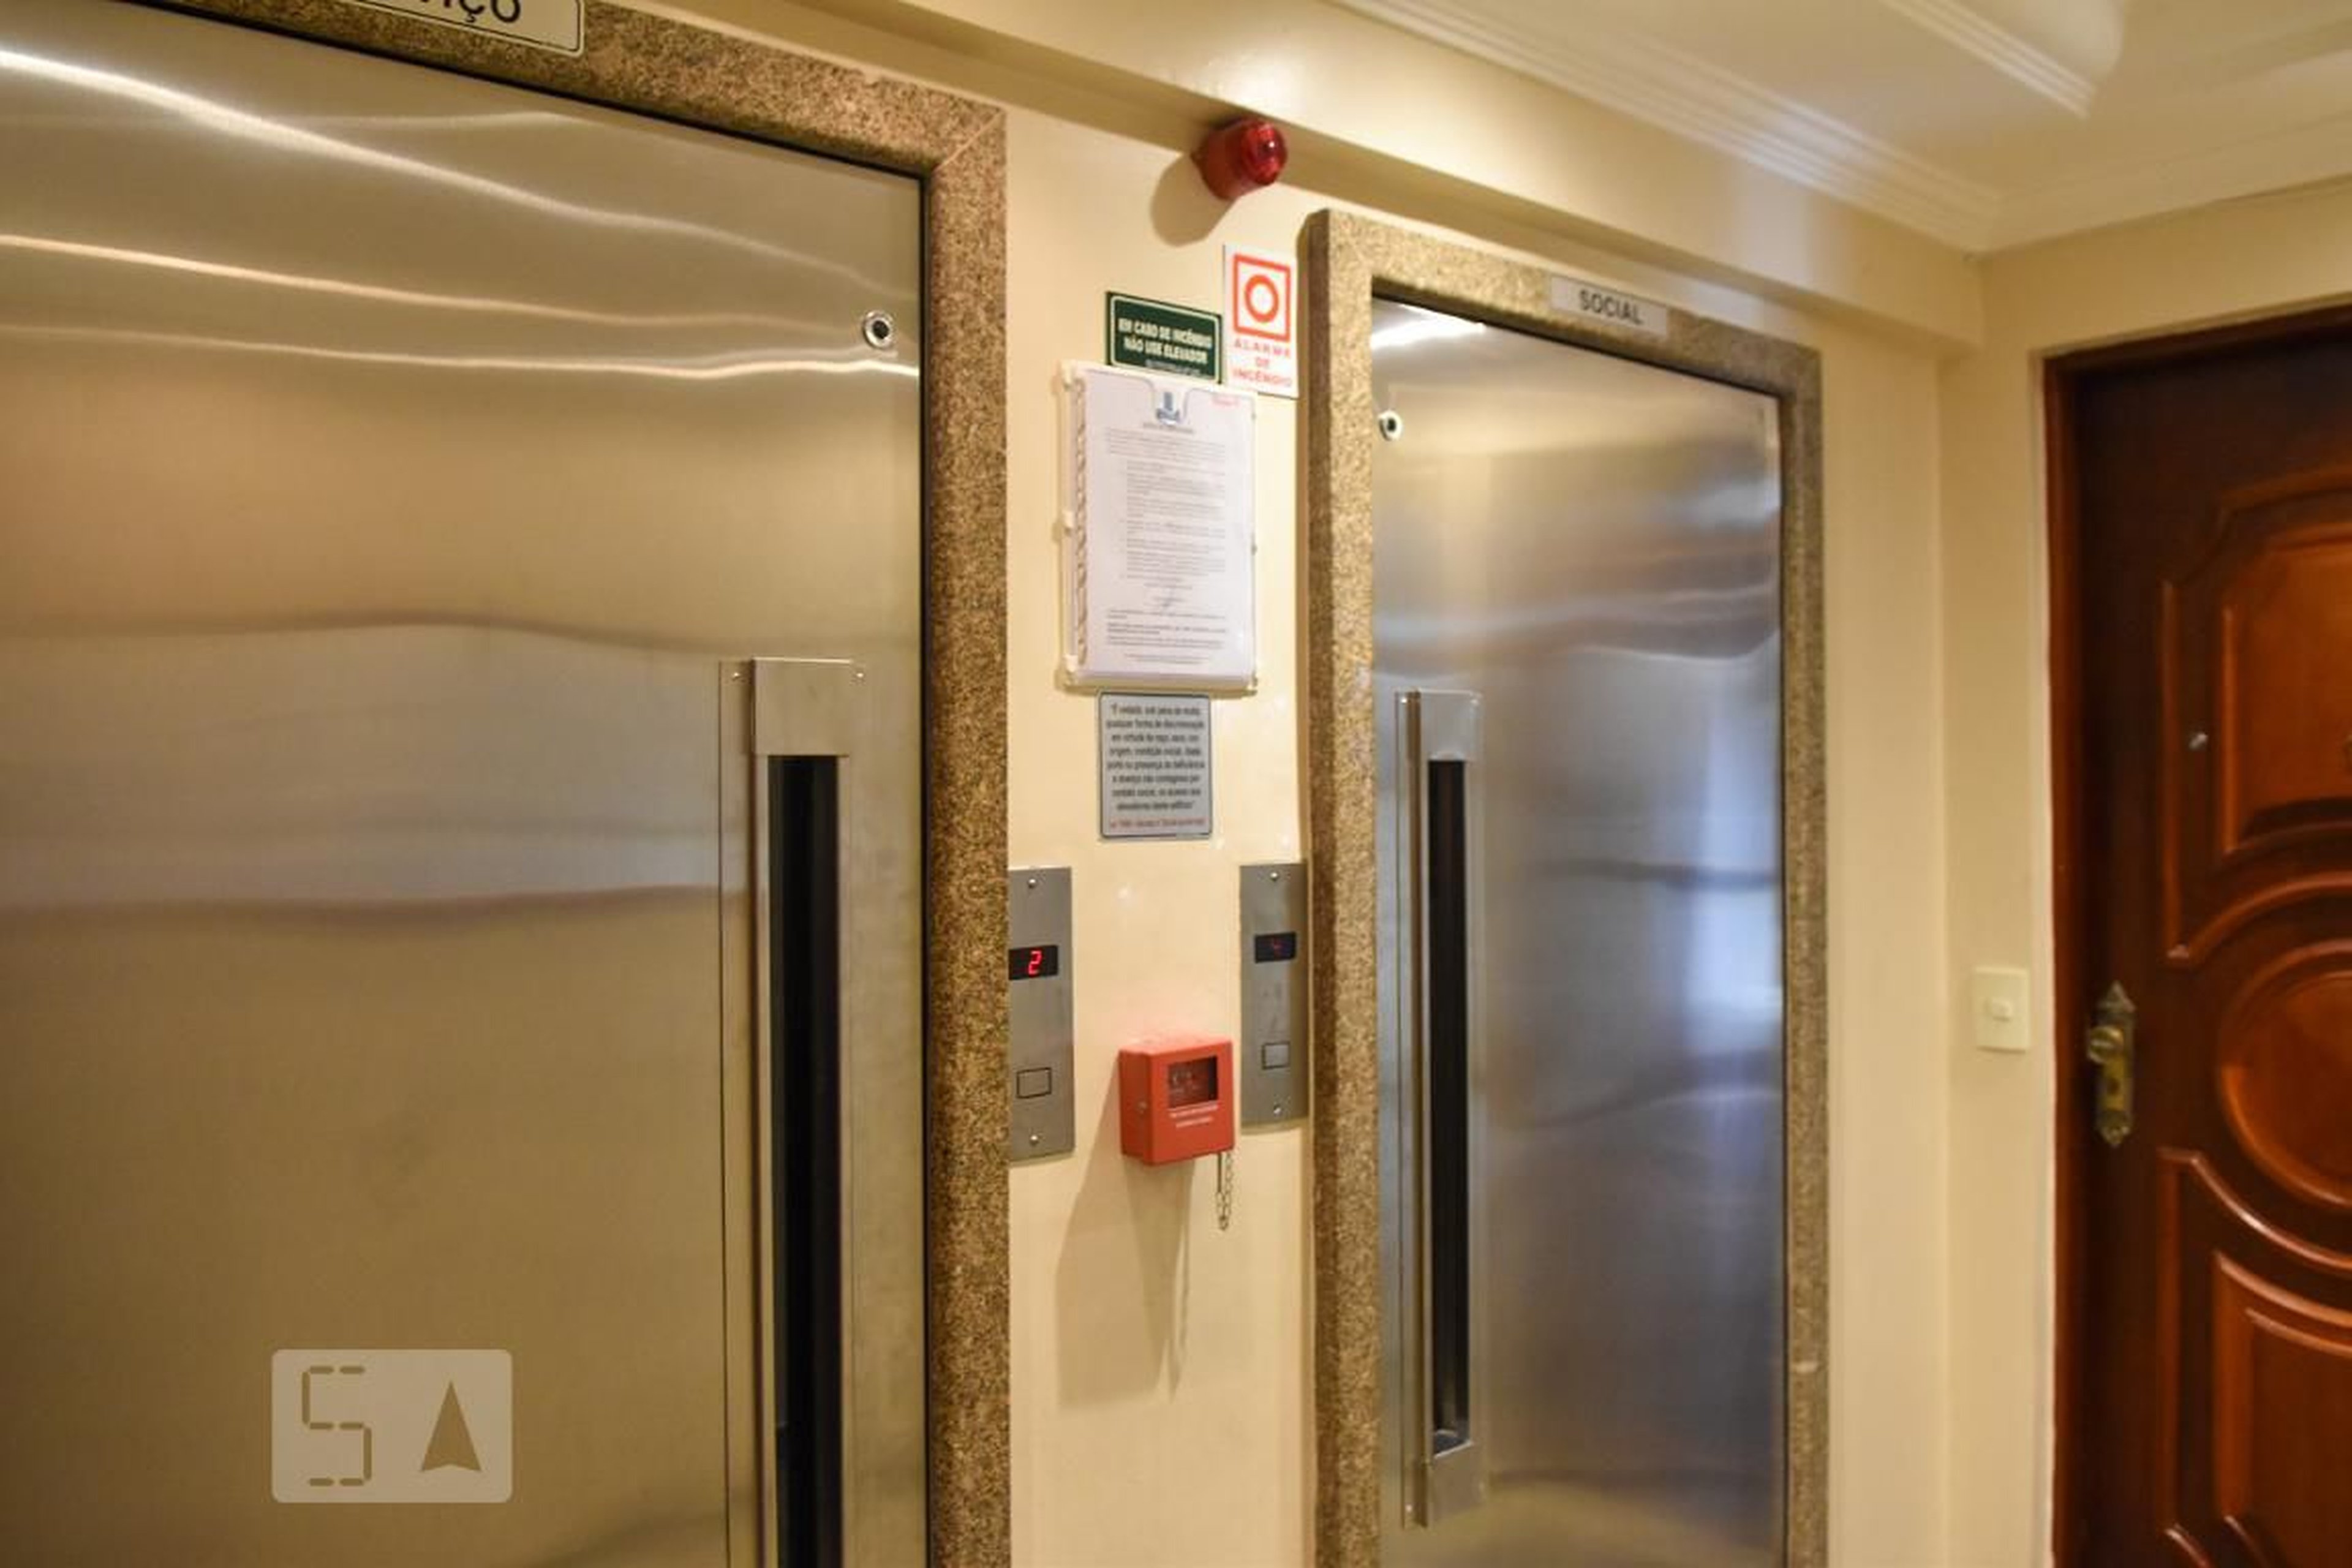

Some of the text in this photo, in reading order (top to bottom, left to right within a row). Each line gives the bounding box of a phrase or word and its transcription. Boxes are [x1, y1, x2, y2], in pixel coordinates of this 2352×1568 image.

[1580, 288, 1643, 325] SOCIAL
[1134, 320, 1158, 337] CASO
[1123, 334, 1208, 365] NÃO USE ELEVADOR
[1234, 337, 1291, 360] ALARME
[1256, 356, 1269, 369] DE
[1232, 368, 1292, 388] INCÊNDIO
[1028, 950, 1042, 975] 2
